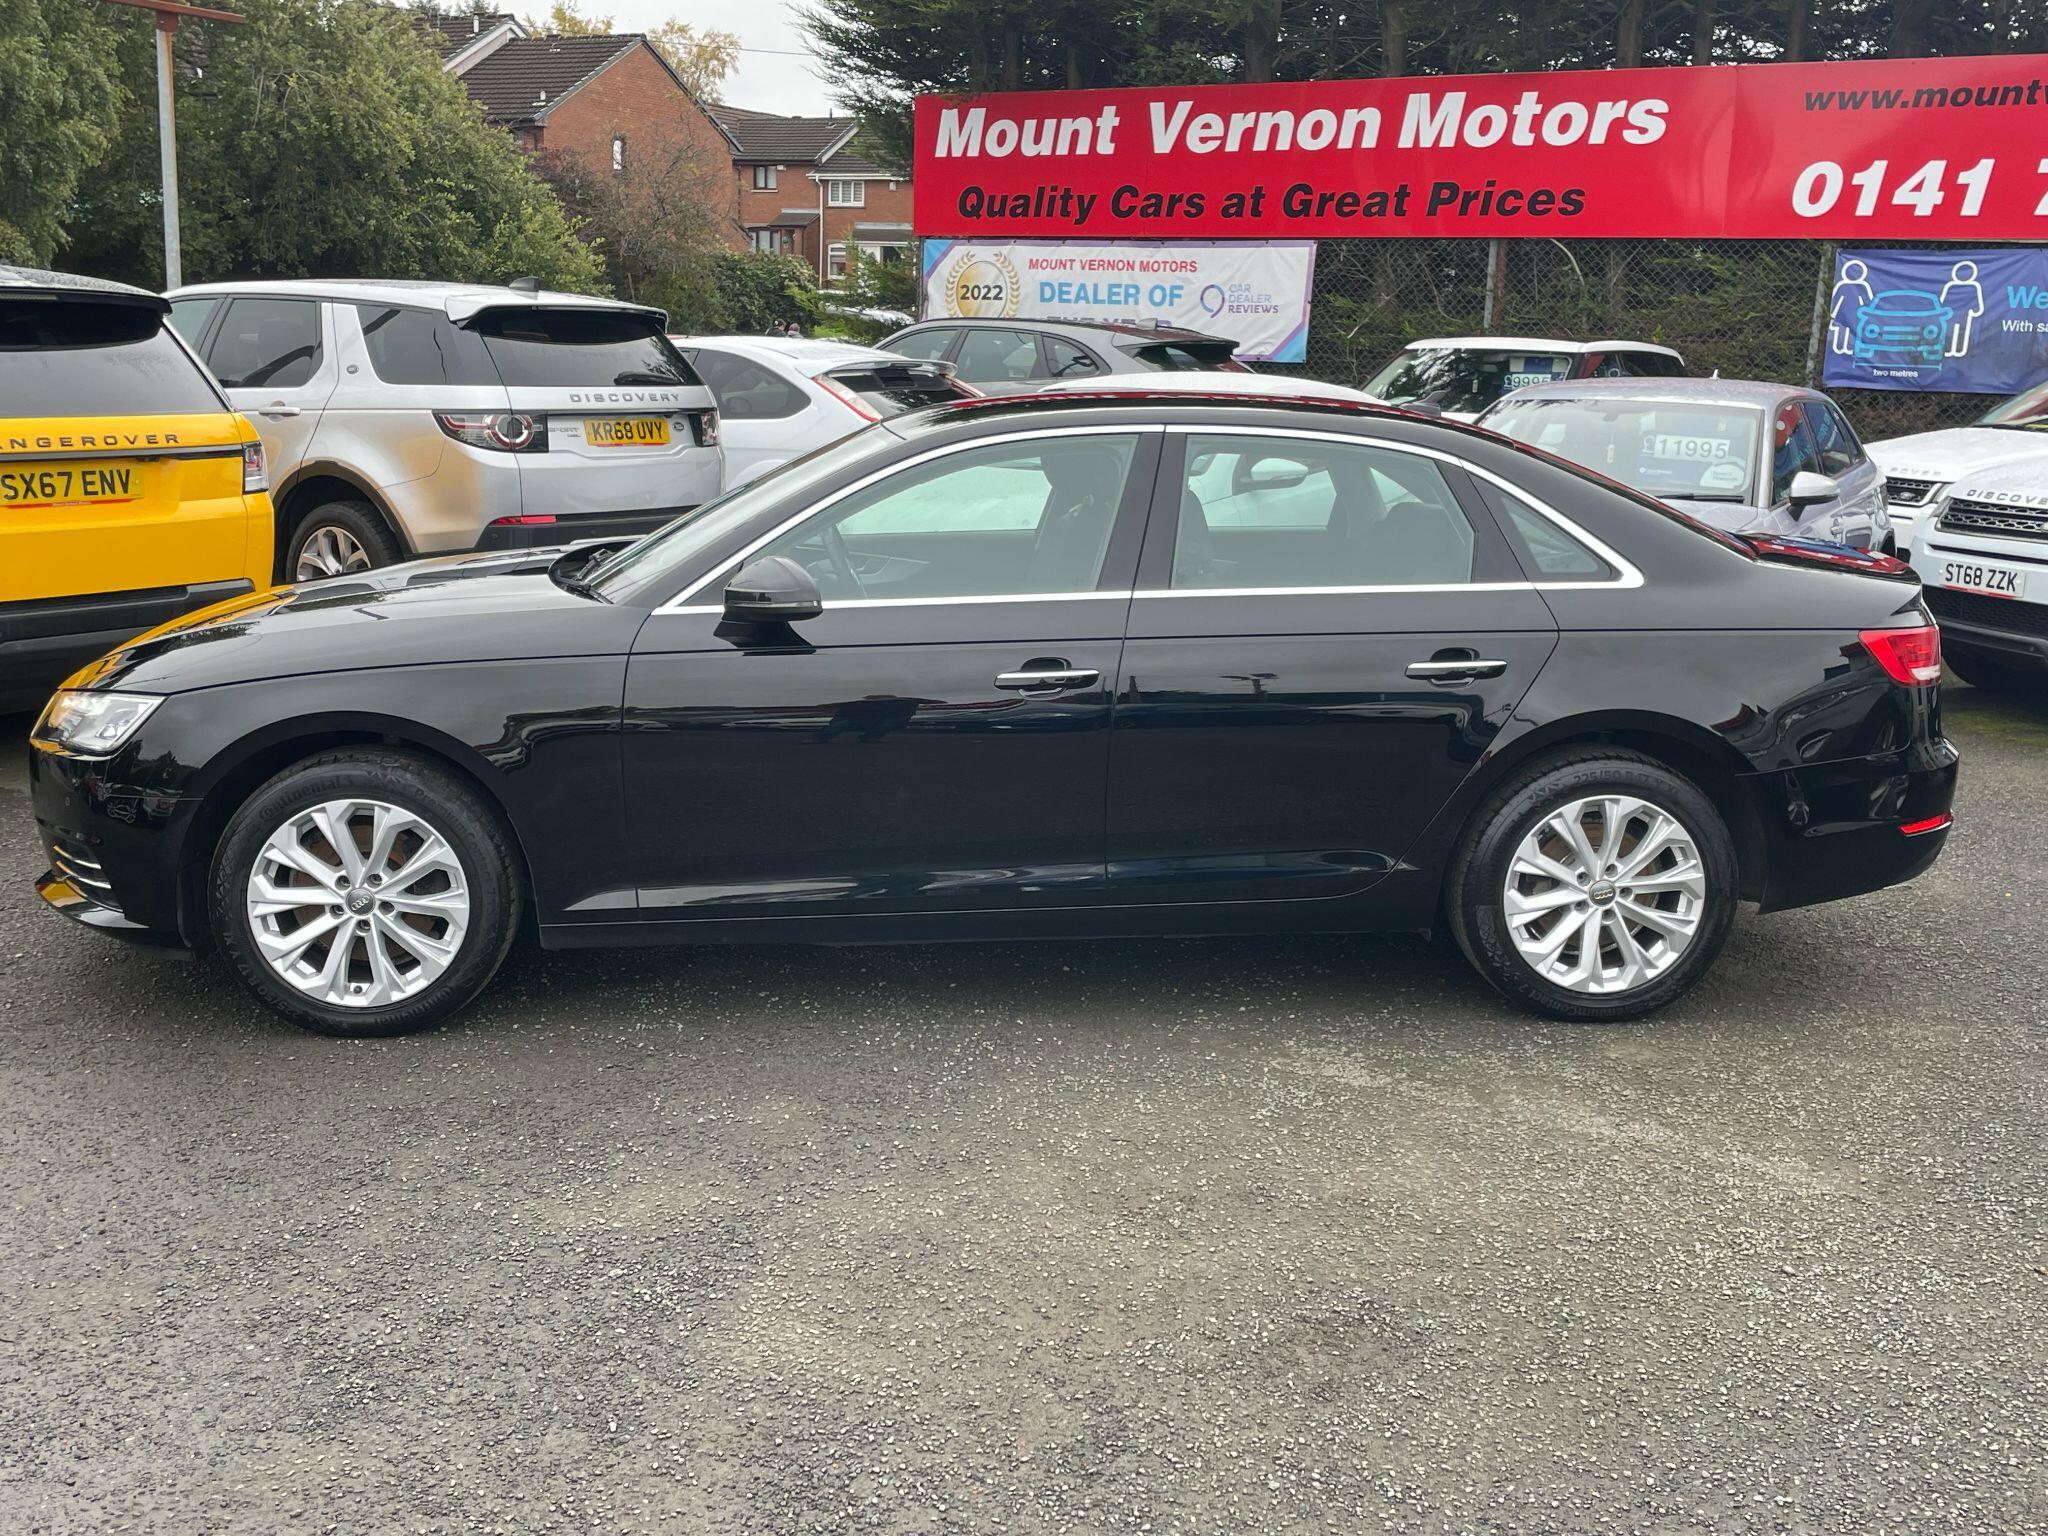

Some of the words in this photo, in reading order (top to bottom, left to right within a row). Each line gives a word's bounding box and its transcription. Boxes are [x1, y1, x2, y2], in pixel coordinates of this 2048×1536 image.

[1805, 79, 2048, 111] www.mount
[935, 105, 1120, 158] Mount
[1149, 100, 1382, 154] Vernon
[1397, 91, 1669, 149] Motors
[1792, 158, 1996, 217] 0141
[958, 185, 1097, 225] Quality
[1111, 184, 1206, 219] Cars
[1221, 185, 1266, 218] at
[1282, 183, 1411, 218] Great
[1426, 180, 1586, 217] Prices
[1028, 258, 1076, 271] MOUNT
[1080, 259, 1136, 272] VERNON
[1139, 260, 1198, 273] MOTORS
[960, 284, 1004, 301] 2022
[1039, 281, 1140, 306] DEALER
[1148, 284, 1184, 307] OF
[1229, 283, 1251, 293] CAR
[1228, 294, 1272, 304] DEALER
[1228, 304, 1280, 314] REVIEWS
[2002, 319, 2034, 332] With
[1873, 369, 1889, 377] two
[1890, 370, 1919, 378] metres
[569, 392, 680, 403] DISCOVERY
[637, 421, 662, 440] UVY
[0, 471, 73, 501] SX67
[81, 469, 131, 496] ENV
[1945, 563, 1983, 586] ST68
[1986, 569, 2018, 592] ZZK
